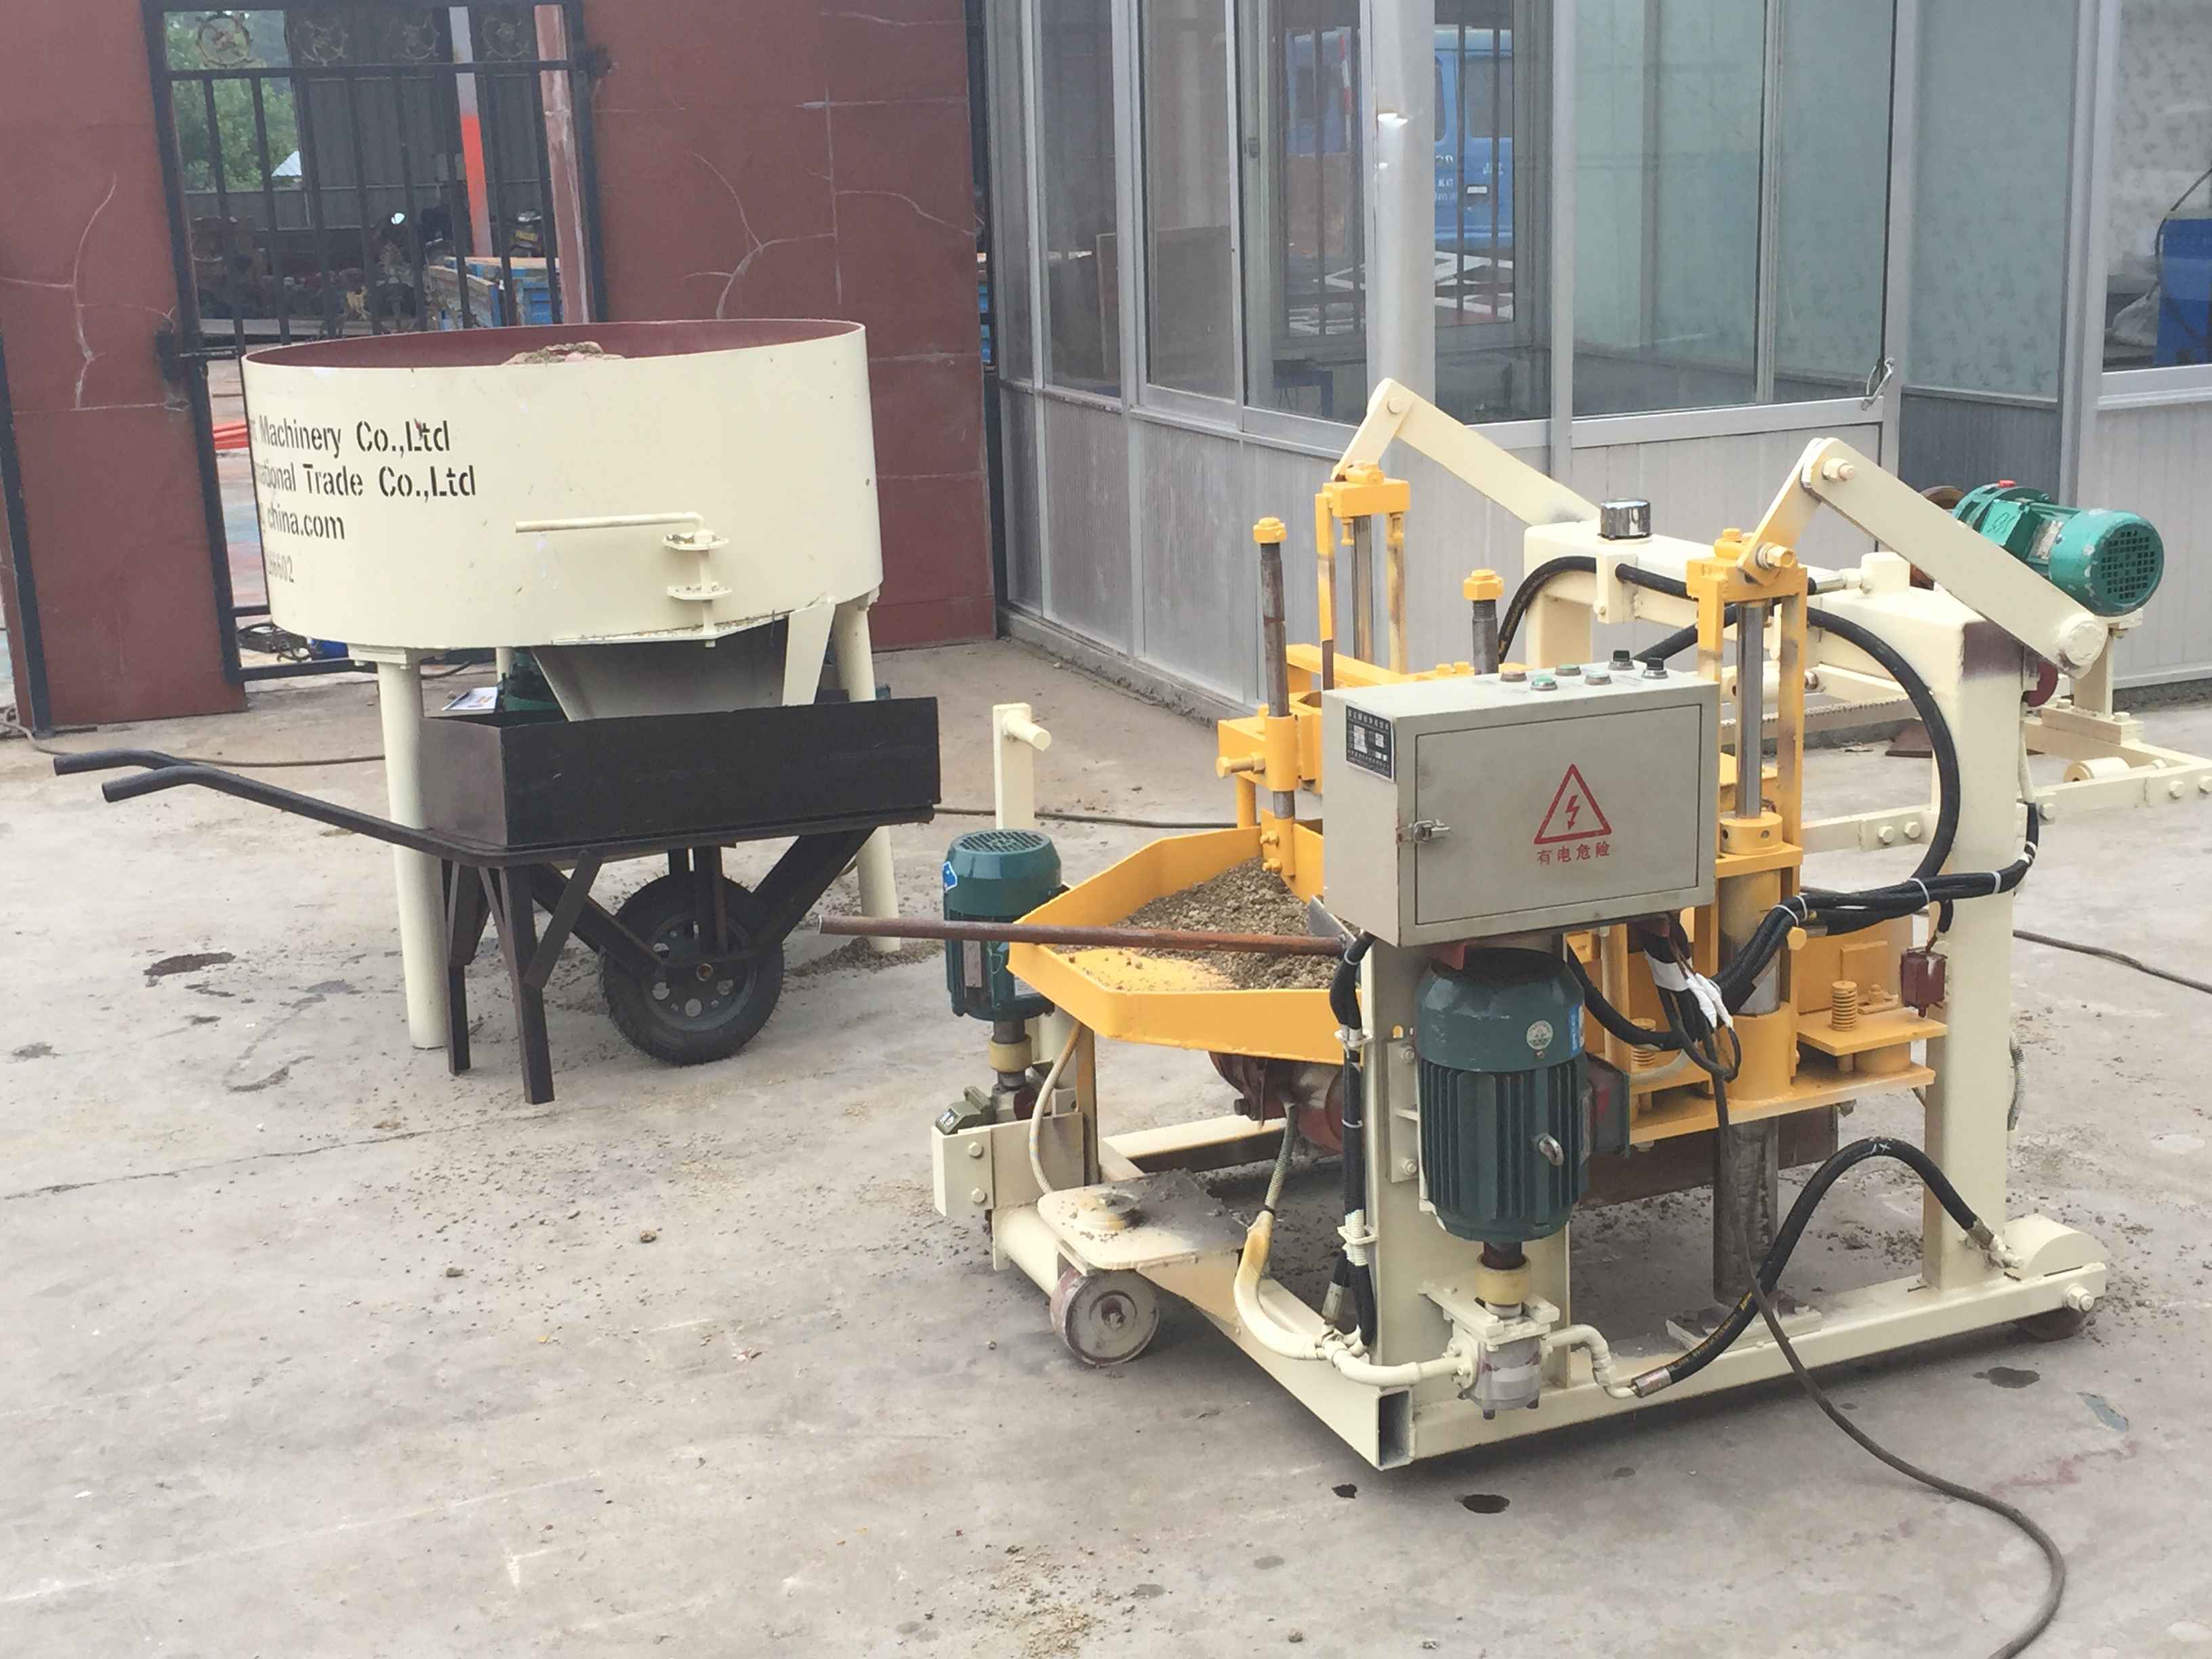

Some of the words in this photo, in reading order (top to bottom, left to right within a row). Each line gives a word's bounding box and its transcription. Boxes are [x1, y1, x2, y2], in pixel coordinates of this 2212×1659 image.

[259, 414, 341, 459] Machinery
[302, 463, 363, 497] Trade
[379, 465, 476, 503] Co.,Ltd
[1536, 840, 1610, 865] 有电危险
